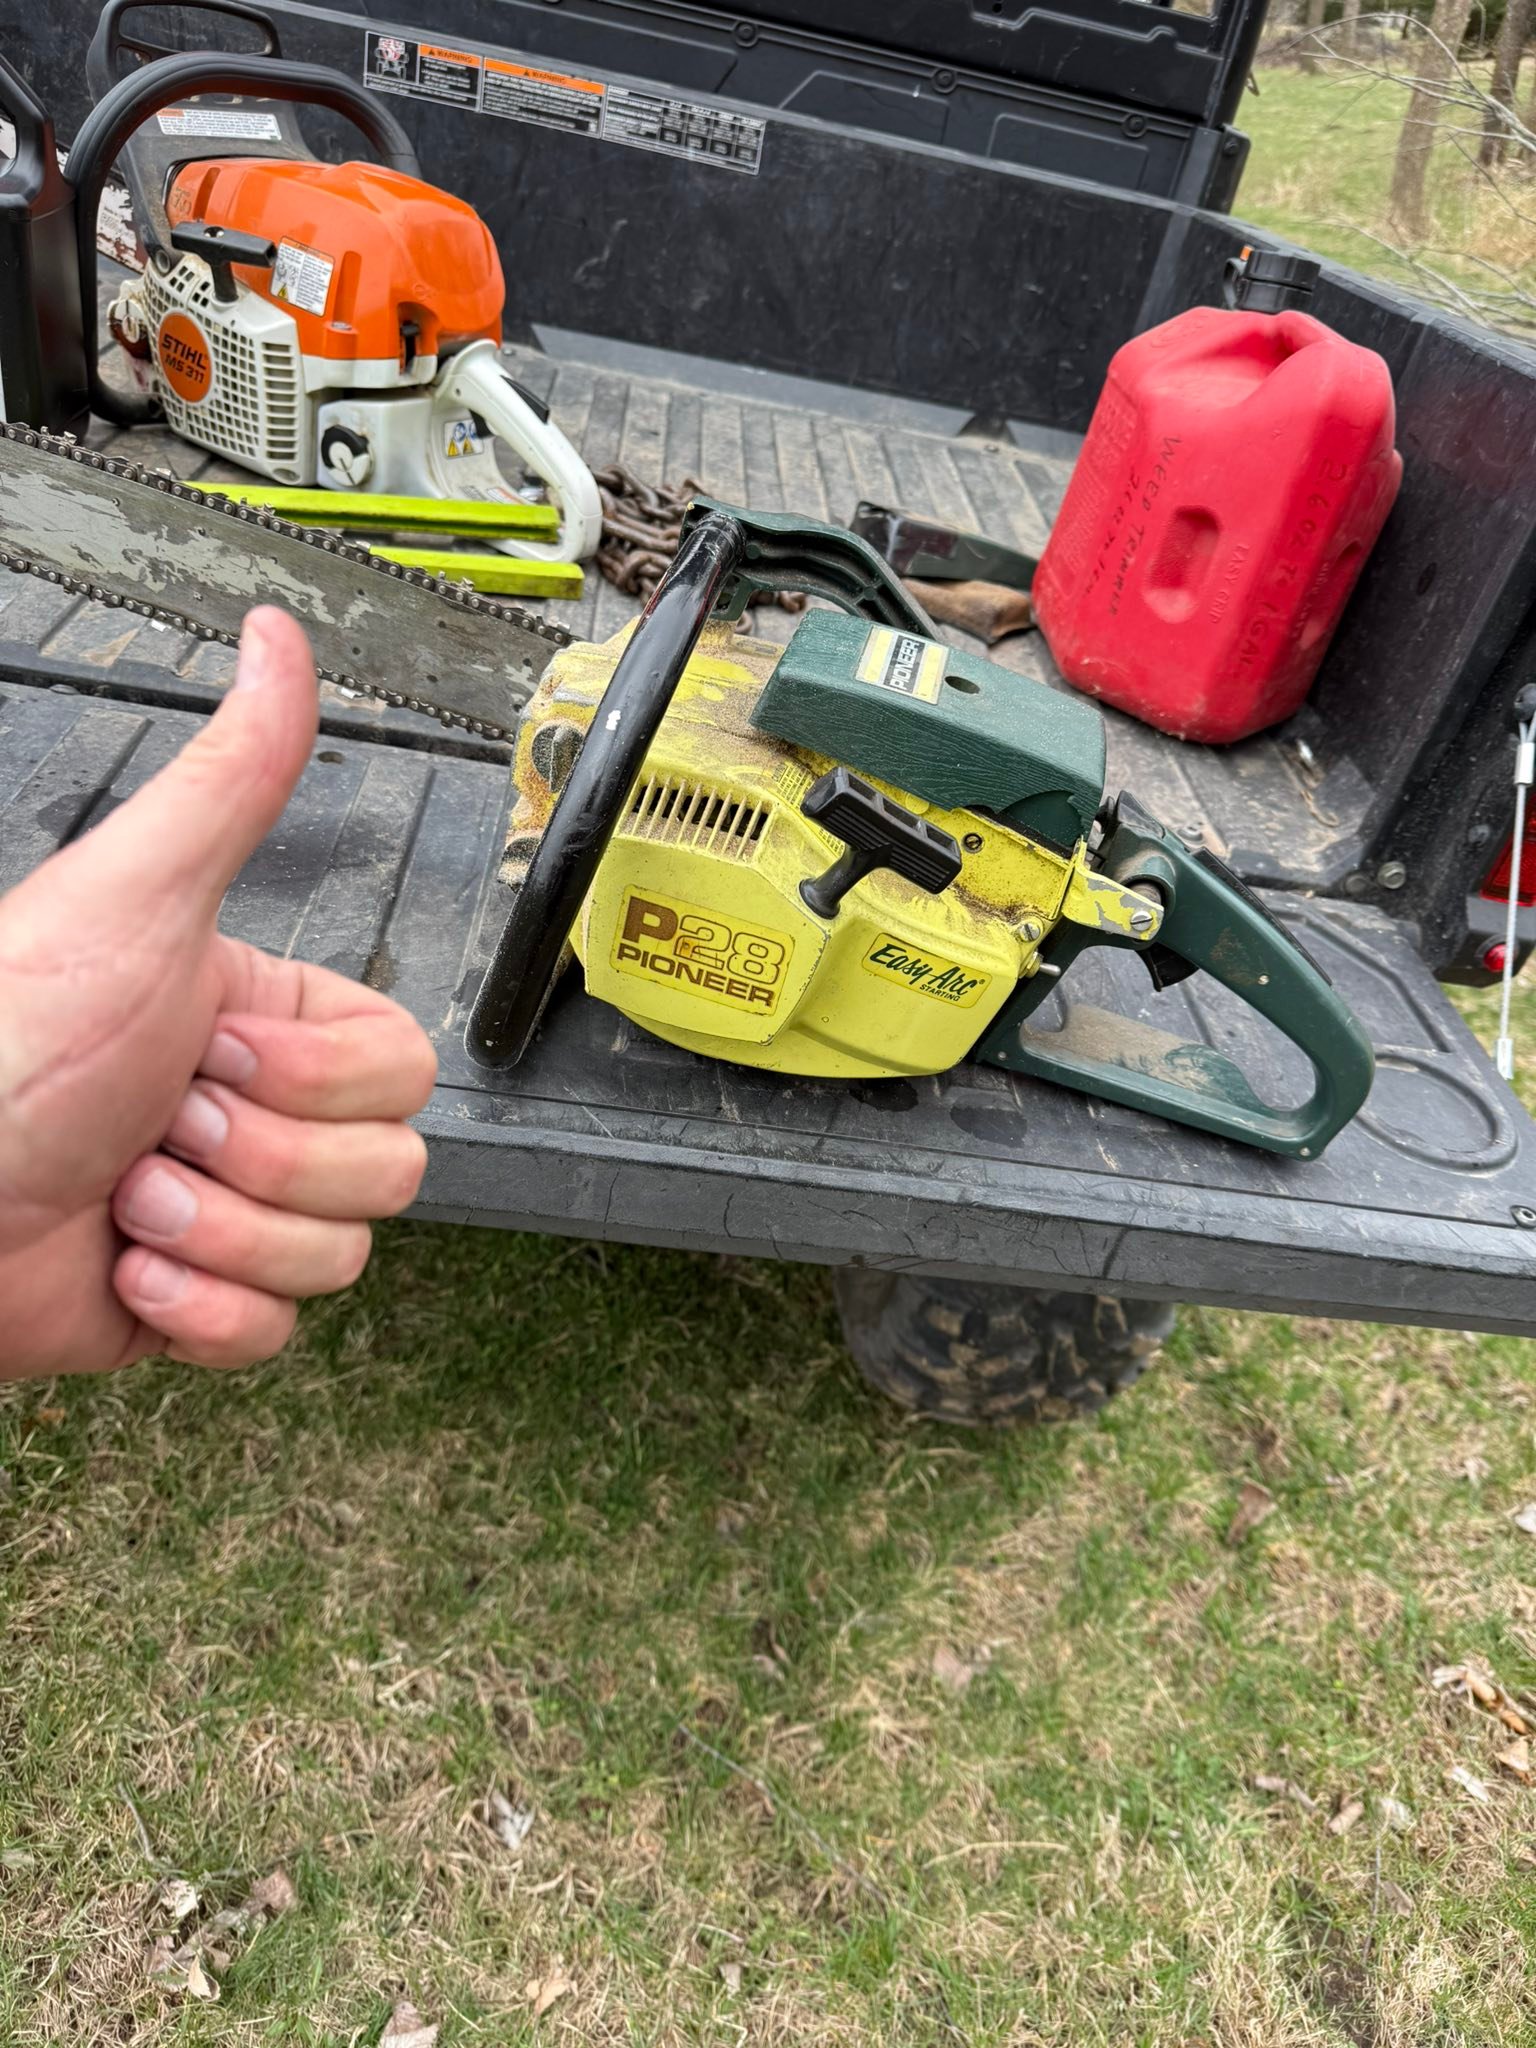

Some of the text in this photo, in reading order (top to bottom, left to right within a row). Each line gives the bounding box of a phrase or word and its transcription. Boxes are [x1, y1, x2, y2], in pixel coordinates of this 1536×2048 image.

[162, 333, 206, 370] STIHL
[165, 354, 204, 384] MS 311
[1142, 437, 1181, 511] WEED
[889, 639, 920, 691] PIONEER
[622, 895, 786, 985] P28
[617, 943, 775, 1008] PIONEER
[869, 943, 933, 985] Easy
[919, 983, 961, 1002] STARTING
